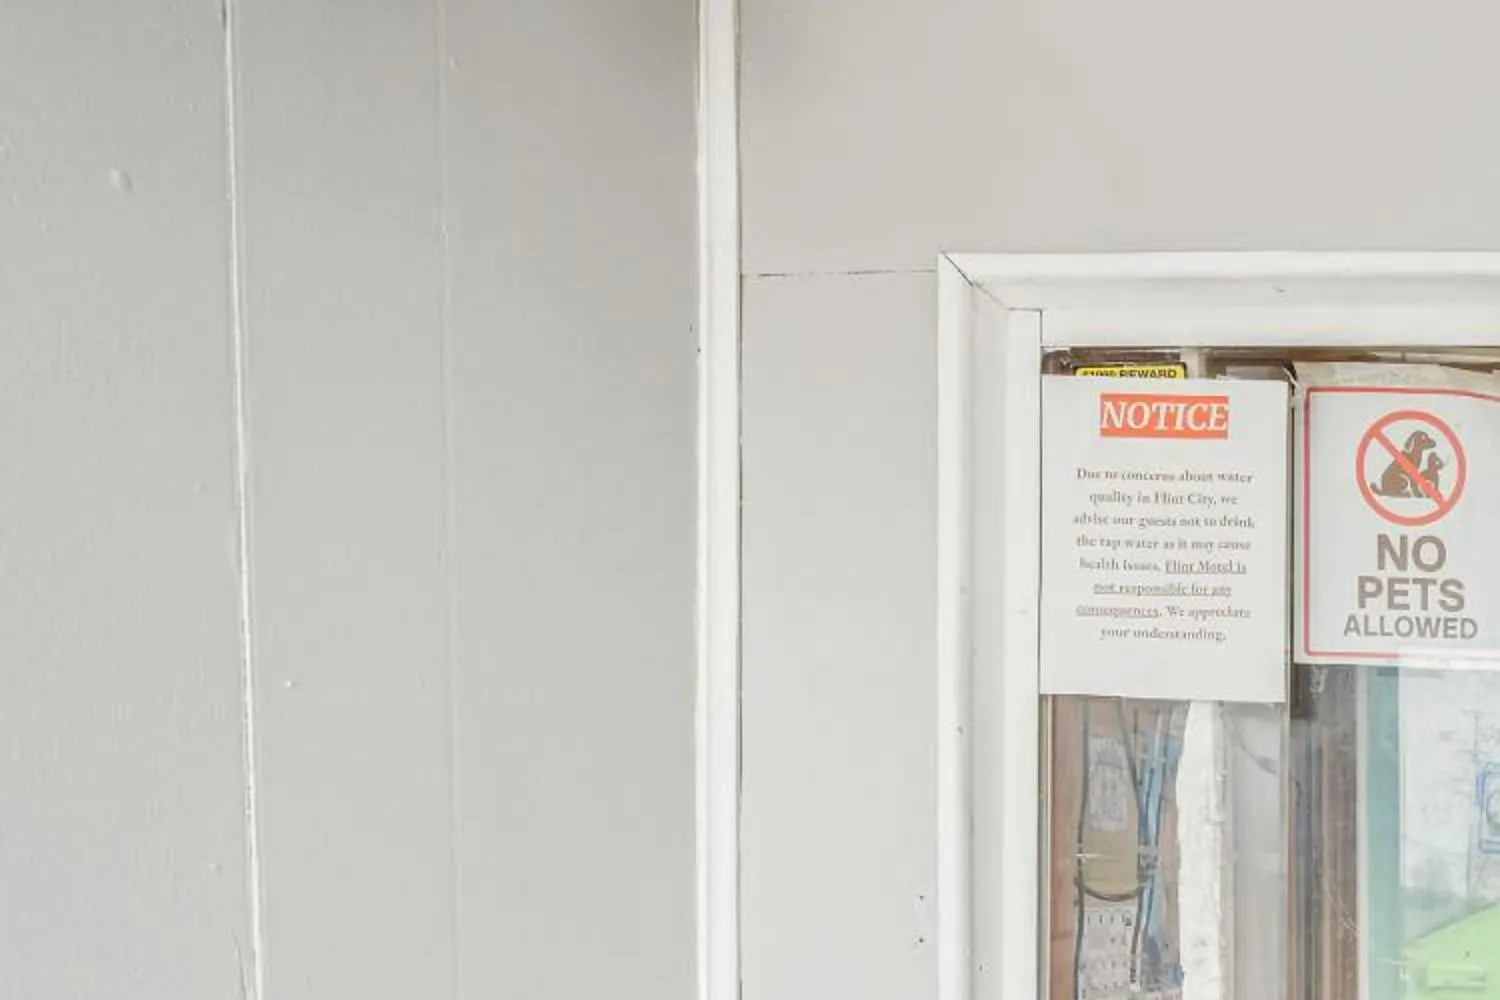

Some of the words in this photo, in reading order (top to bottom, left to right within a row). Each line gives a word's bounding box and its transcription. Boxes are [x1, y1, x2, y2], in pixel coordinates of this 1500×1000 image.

[1101, 401, 1229, 432] NOTICE
[1077, 468, 1102, 481] Due
[1105, 469, 1119, 481] to
[1121, 471, 1176, 482] concerns
[1179, 470, 1214, 483] about
[1217, 471, 1253, 484] water
[1089, 492, 1134, 507] quality
[1137, 492, 1150, 505] in
[1154, 491, 1184, 506] Flint
[1187, 493, 1217, 509] City,
[1221, 496, 1238, 506] we
[1073, 513, 1110, 526] advise
[1113, 516, 1136, 527] our
[1137, 517, 1177, 530] guests
[1179, 516, 1201, 528] not
[1203, 516, 1217, 528] to
[1076, 535, 1097, 548] the
[1100, 536, 1121, 551] tap
[1125, 537, 1159, 550] water
[1163, 540, 1175, 550] as
[1178, 537, 1188, 550] it
[1191, 540, 1214, 553] may
[1218, 541, 1251, 551] cause
[1377, 533, 1447, 573] NO
[1079, 557, 1119, 572] health
[1165, 560, 1197, 574] Flint
[1199, 559, 1235, 575] Motel
[1237, 559, 1247, 574] is
[1094, 582, 1116, 594] not
[1119, 580, 1187, 597] responsible
[1190, 581, 1209, 595] for
[1211, 586, 1232, 598] any
[1357, 575, 1465, 612] PETS
[1167, 605, 1185, 617] We
[1188, 606, 1251, 620] appreciate
[1100, 627, 1131, 640] your
[1133, 625, 1226, 641] understanding.
[1343, 613, 1478, 640] ALLOWED
